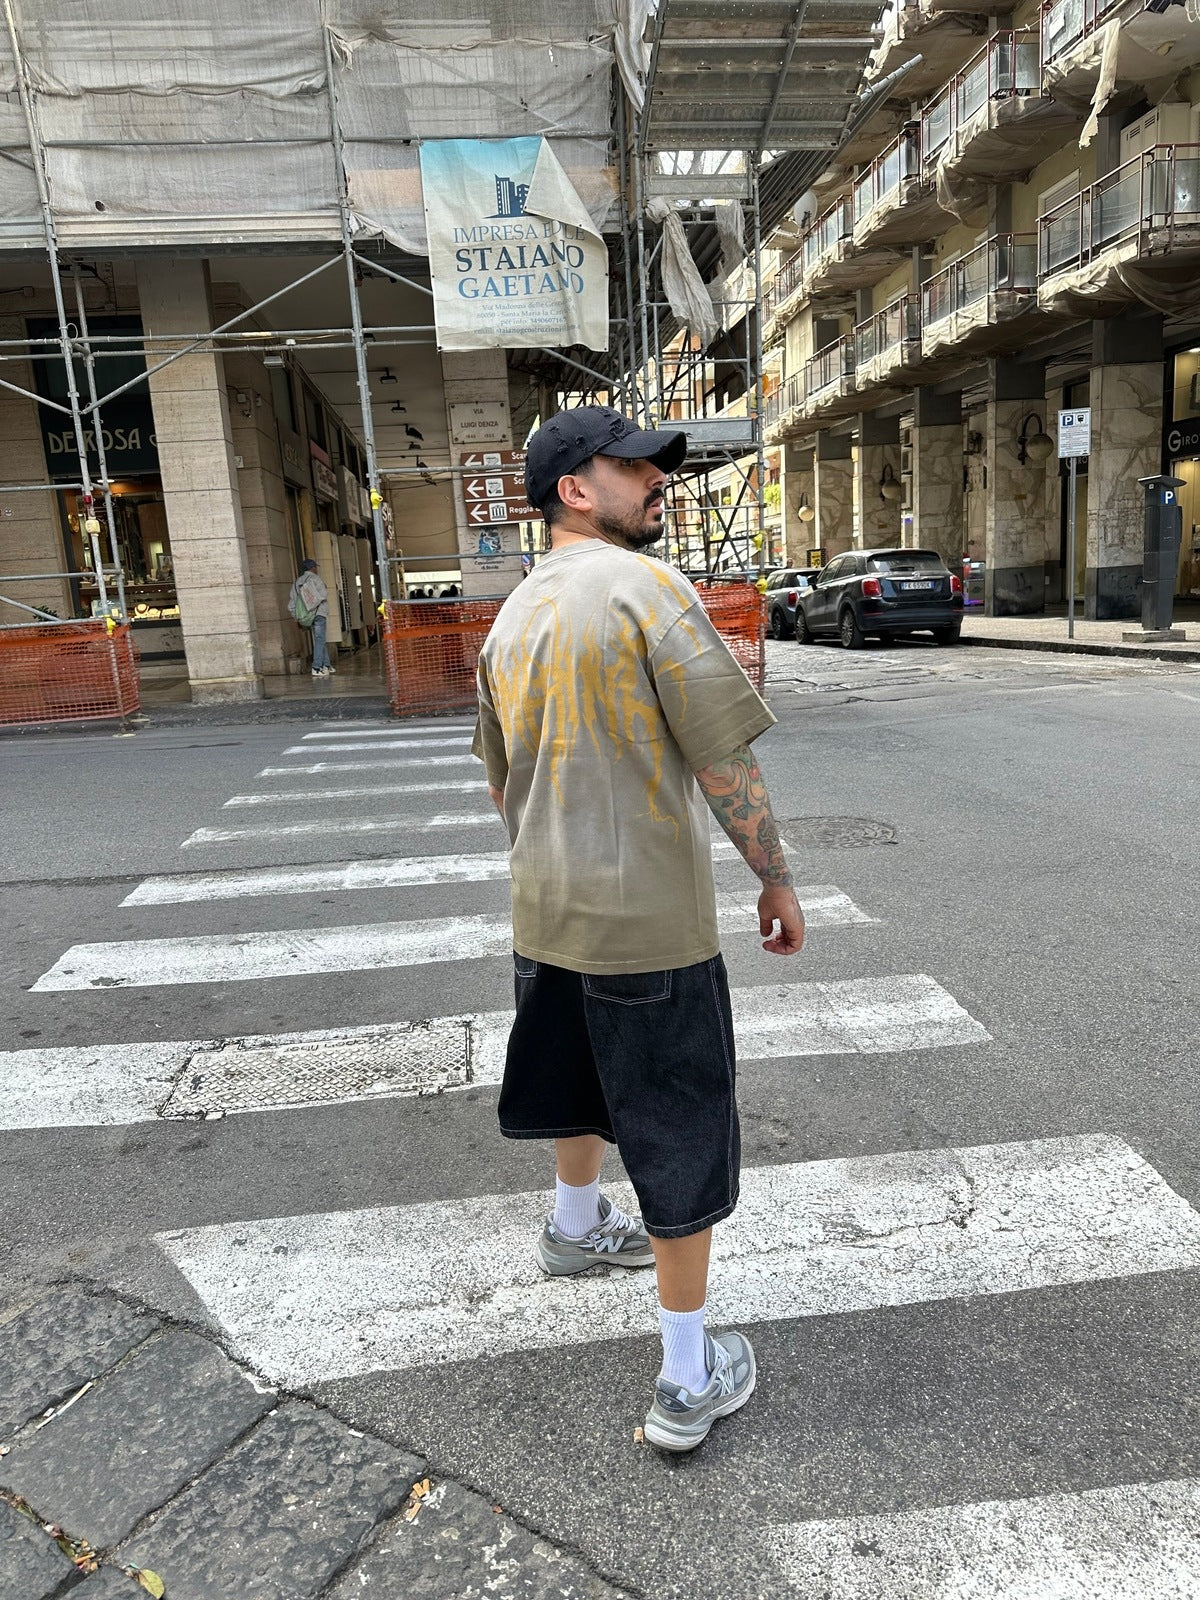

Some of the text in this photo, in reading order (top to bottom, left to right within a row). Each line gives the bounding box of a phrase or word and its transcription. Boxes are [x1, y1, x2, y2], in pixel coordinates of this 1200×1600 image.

[453, 224, 538, 243] IMPRESA
[455, 239, 585, 272] STAIANO
[457, 267, 584, 299] GAETANO
[478, 420, 499, 428] DENZA
[1065, 416, 1073, 426] P
[47, 431, 78, 454] DE
[82, 427, 142, 452] ROSA
[1167, 430, 1200, 452] GIRO
[1165, 491, 1173, 504] P
[509, 505, 534, 514] Reggia
